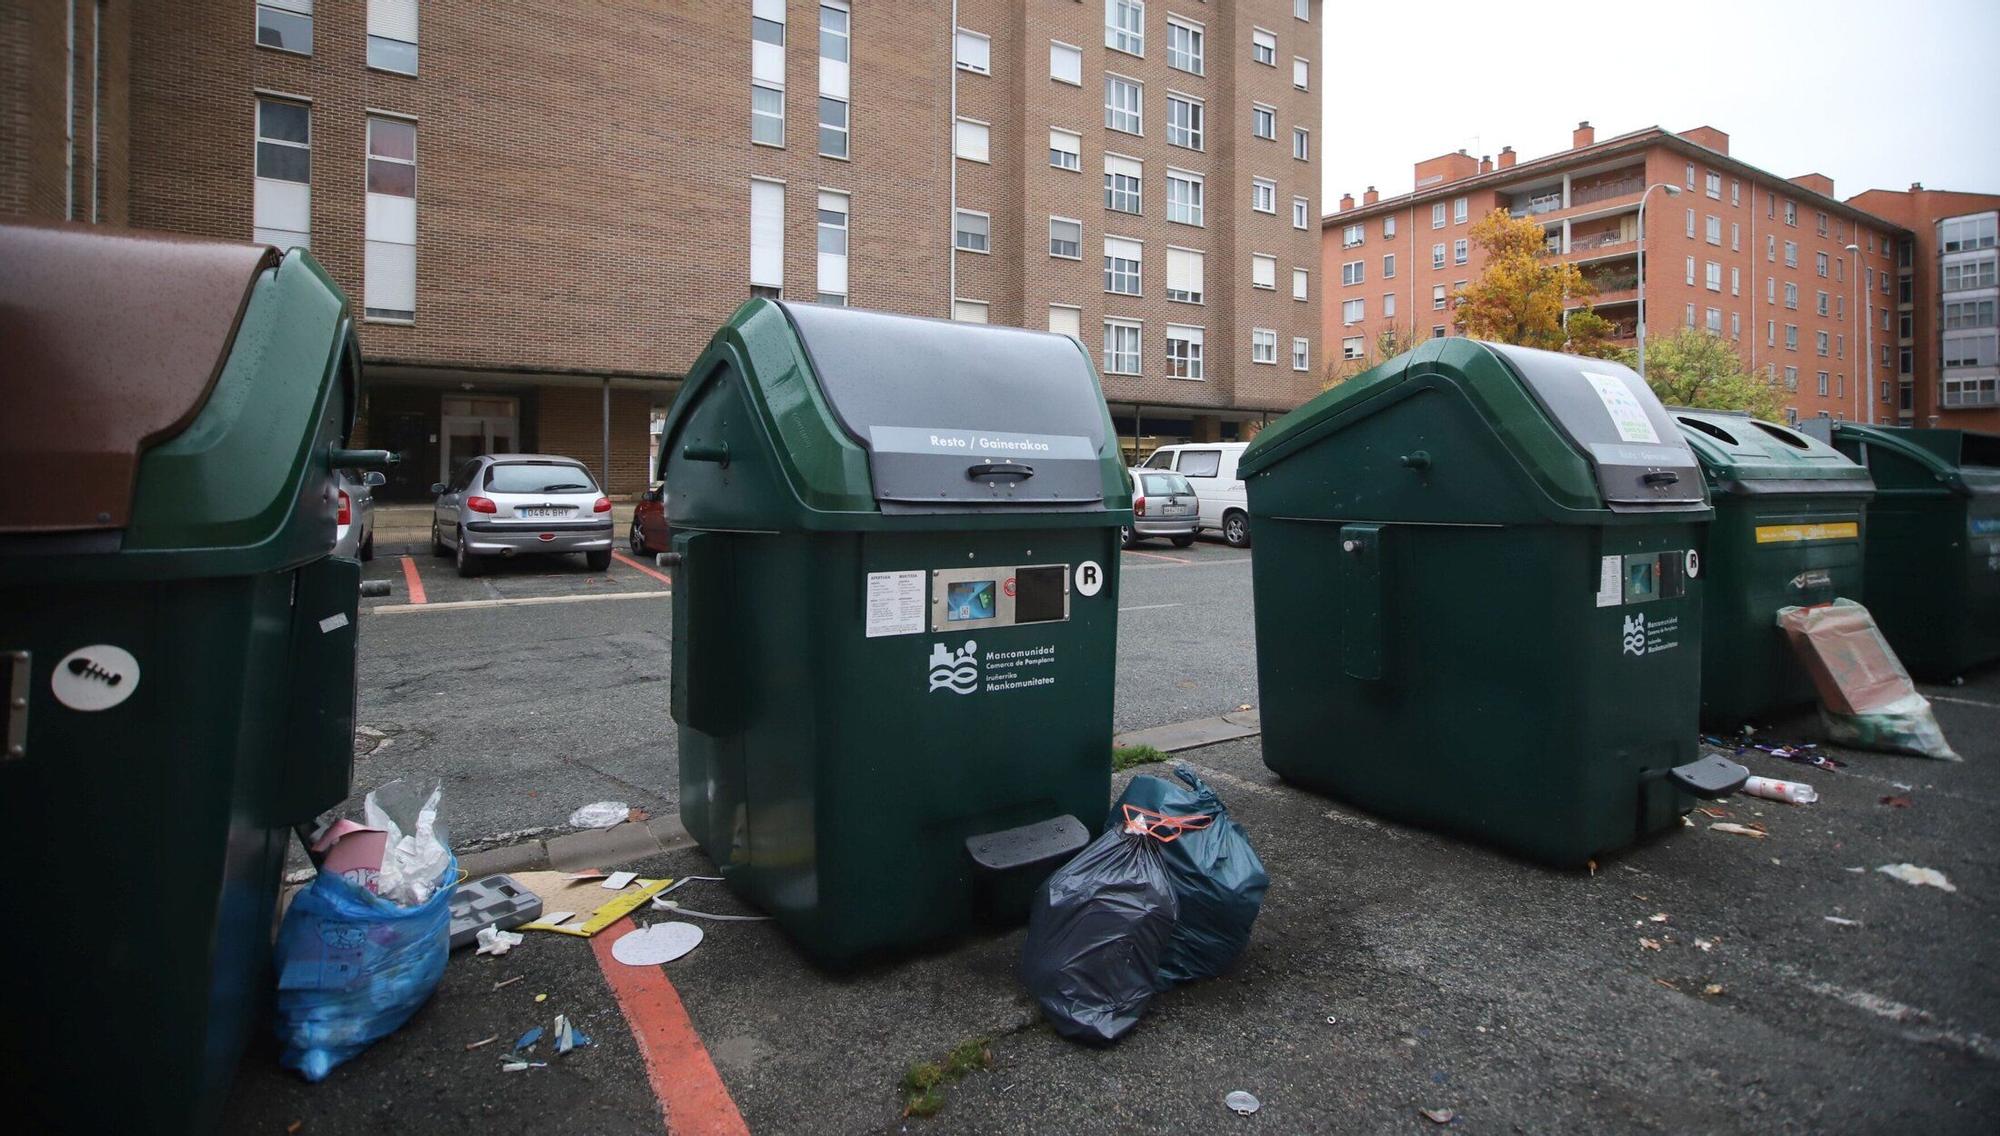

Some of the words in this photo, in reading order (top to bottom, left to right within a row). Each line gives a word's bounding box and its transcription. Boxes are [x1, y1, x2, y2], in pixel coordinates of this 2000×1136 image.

[930, 435, 966, 448] Resto
[970, 436, 975, 450] /
[979, 437, 1049, 451] Gainerakoa
[1690, 554, 1697, 569] R
[1083, 565, 1098, 586] R
[986, 644, 1055, 661] Mancomunidad
[1015, 659, 1024, 667] de
[1024, 657, 1055, 666] Pamplona
[986, 677, 1055, 692] Mankomunitatea
